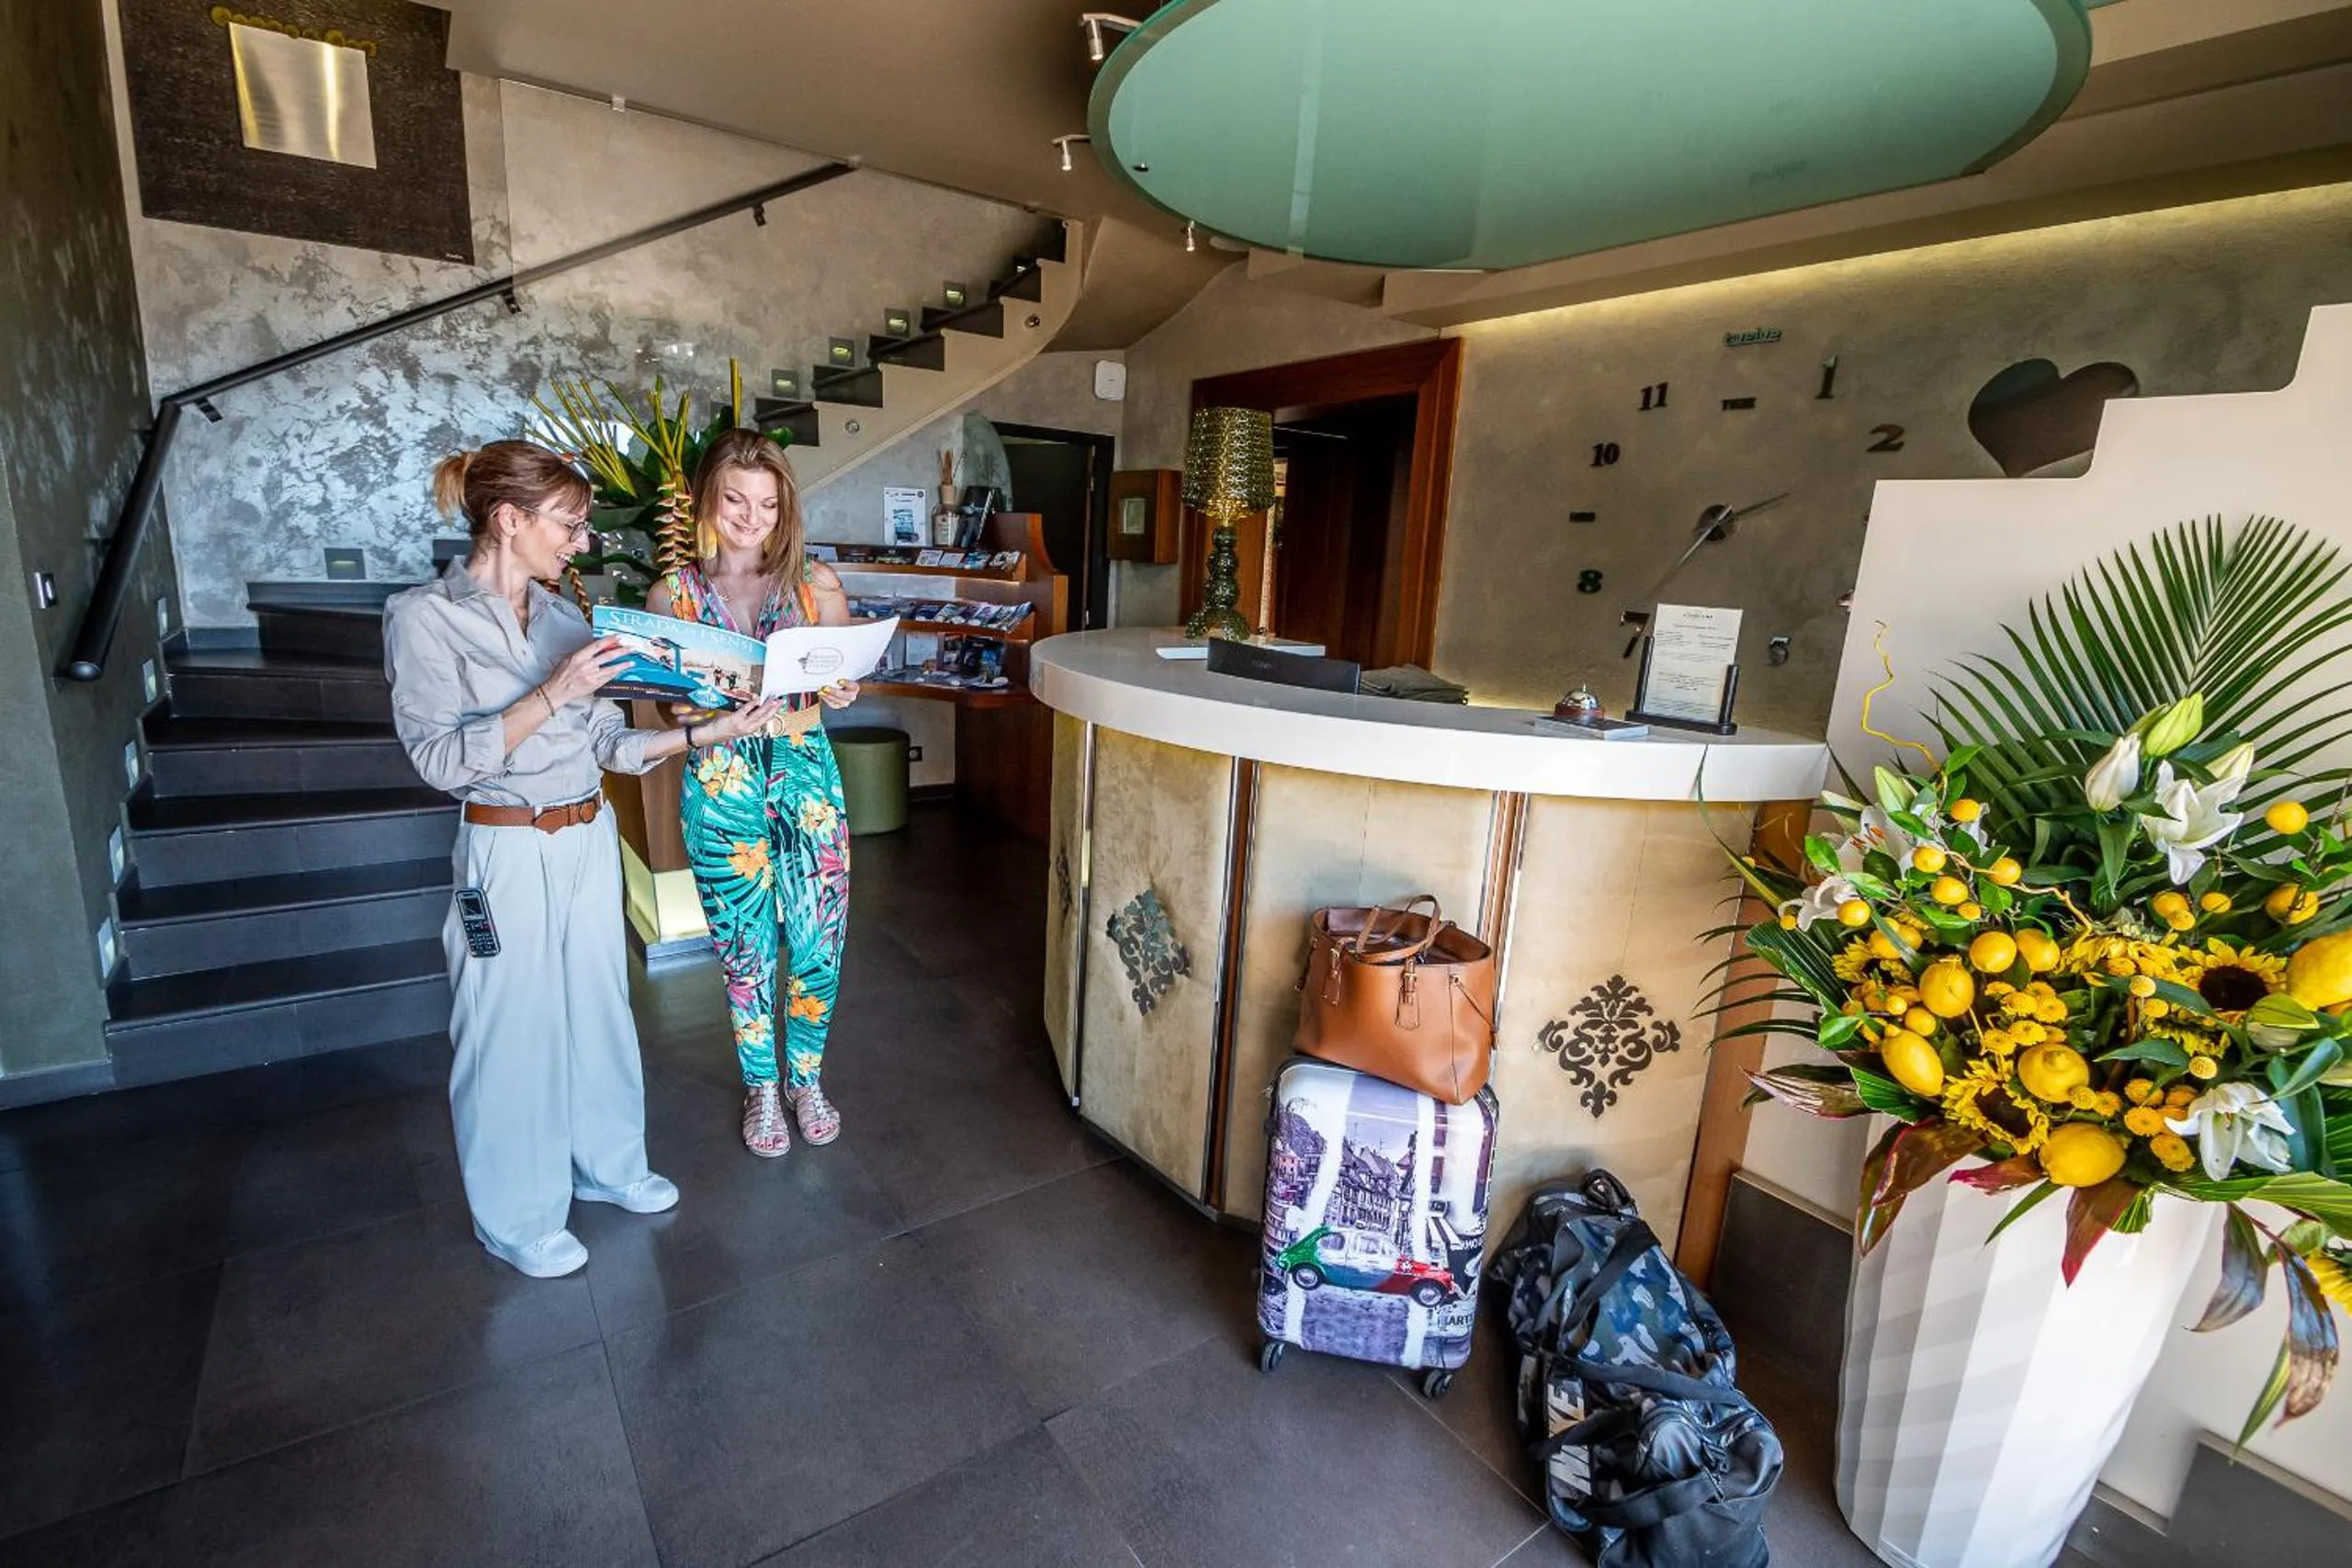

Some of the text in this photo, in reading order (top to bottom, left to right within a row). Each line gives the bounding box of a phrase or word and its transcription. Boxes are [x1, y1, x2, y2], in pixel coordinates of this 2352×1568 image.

[1815, 355, 1838, 400] 1
[1637, 382, 1668, 412] 11
[1866, 423, 1905, 453] 2
[1590, 443, 1621, 467] 10
[1577, 570, 1602, 593] 8
[1621, 610, 1650, 659] 7
